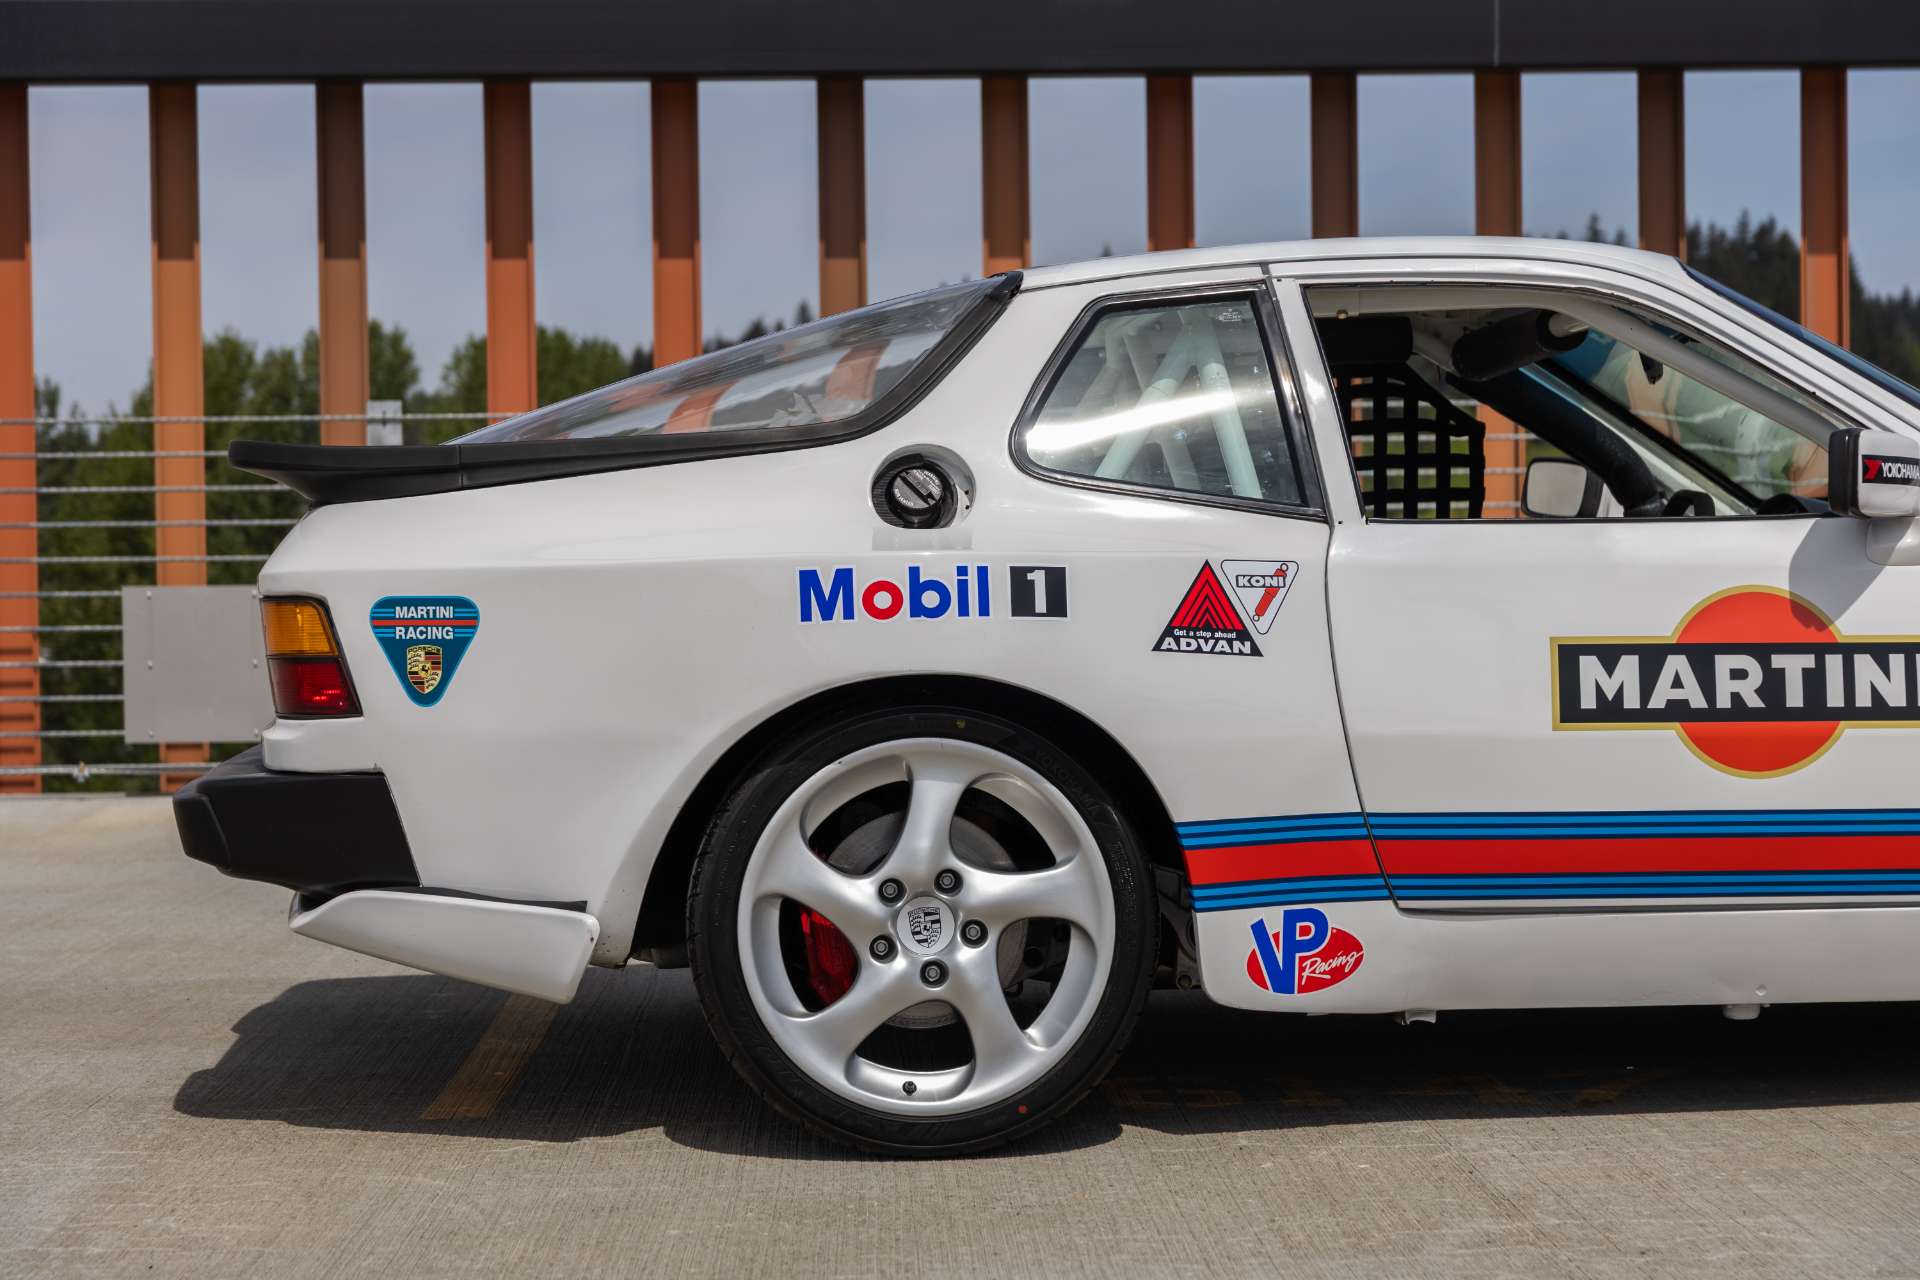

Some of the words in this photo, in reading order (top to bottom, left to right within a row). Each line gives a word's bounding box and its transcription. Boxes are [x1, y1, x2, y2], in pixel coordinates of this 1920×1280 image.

[1881, 462, 1920, 480] YOKOHAMA
[1237, 575, 1285, 588] KONI
[798, 565, 990, 623] Mobil
[1026, 569, 1047, 614] 1
[395, 606, 454, 619] MARTINI
[395, 626, 454, 640] RACING
[1173, 628, 1187, 636] Get
[1214, 631, 1237, 639] ahead
[1159, 637, 1251, 654] ADVAN
[1578, 653, 1920, 710] MARTIN
[1250, 907, 1329, 995] VP
[1301, 950, 1364, 986] Racing
